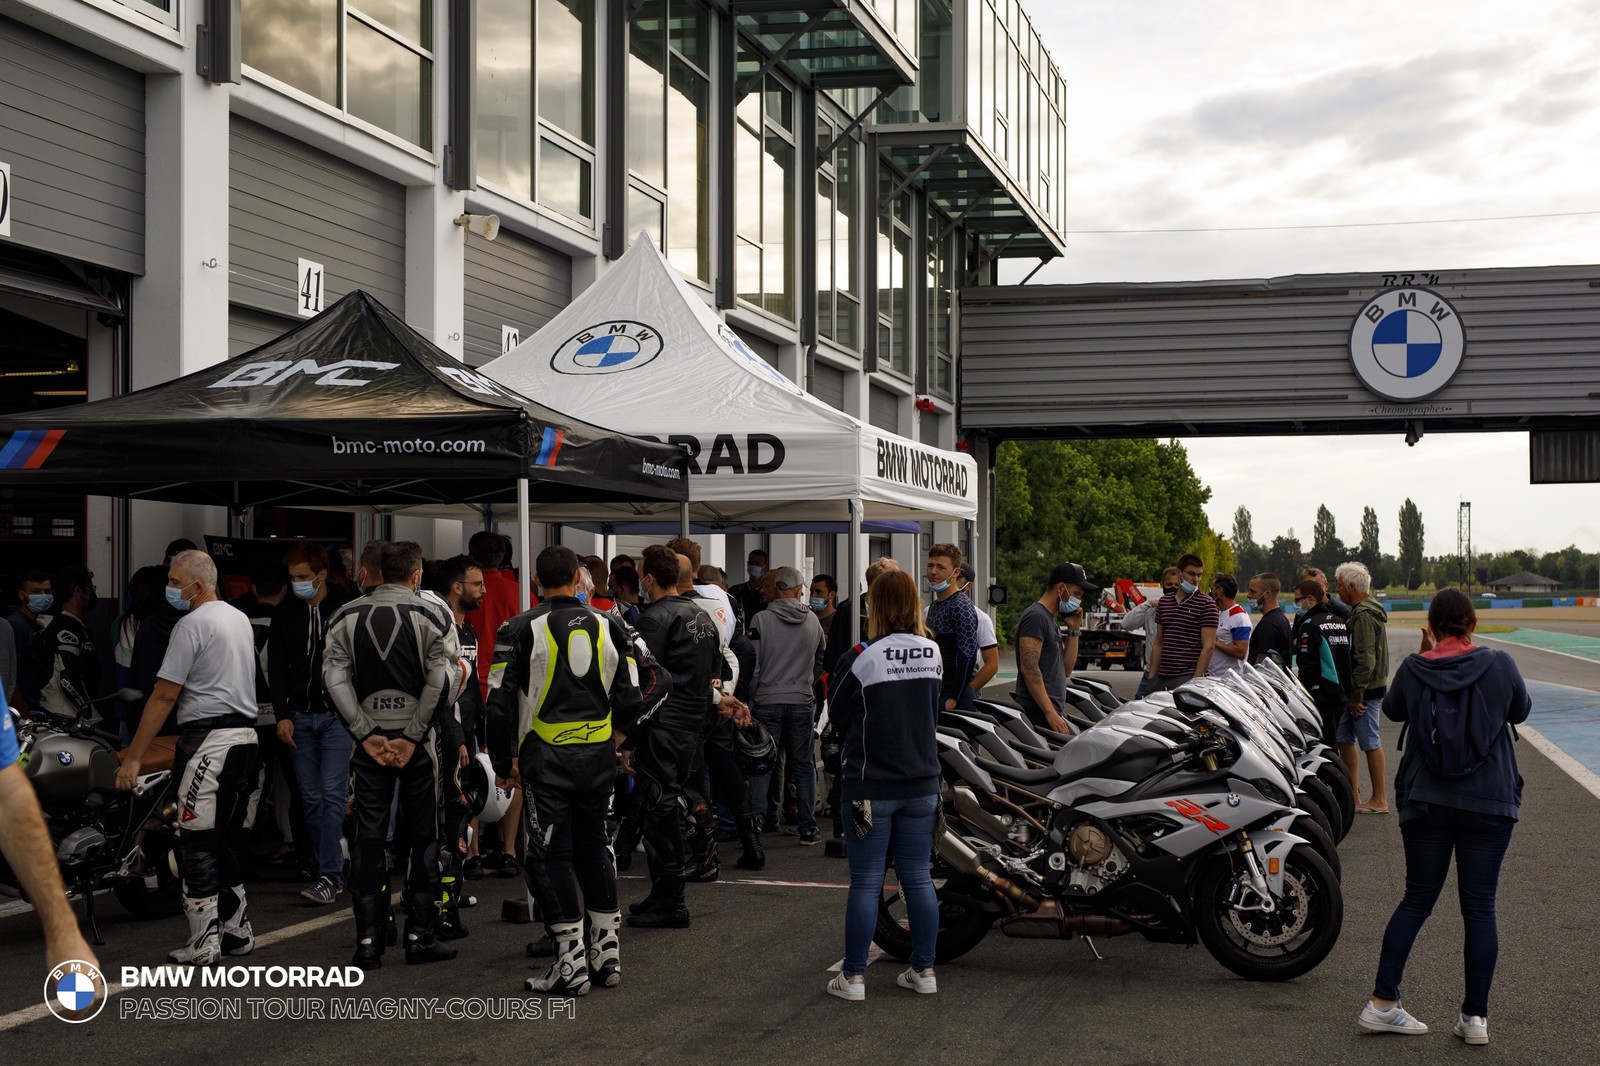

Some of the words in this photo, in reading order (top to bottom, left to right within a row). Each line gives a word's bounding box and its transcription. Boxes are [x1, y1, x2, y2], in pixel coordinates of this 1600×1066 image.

[301, 267, 321, 312] 41
[1364, 292, 1451, 324] BMW
[576, 324, 654, 344] BMW
[207, 359, 401, 388] BMC
[1374, 405, 1445, 415] Chronographes
[332, 436, 485, 454] bmc-moto.com
[629, 433, 785, 474] RAD
[877, 437, 907, 483] BMW
[910, 448, 968, 497] MOTORRAD
[883, 647, 933, 664] tyco
